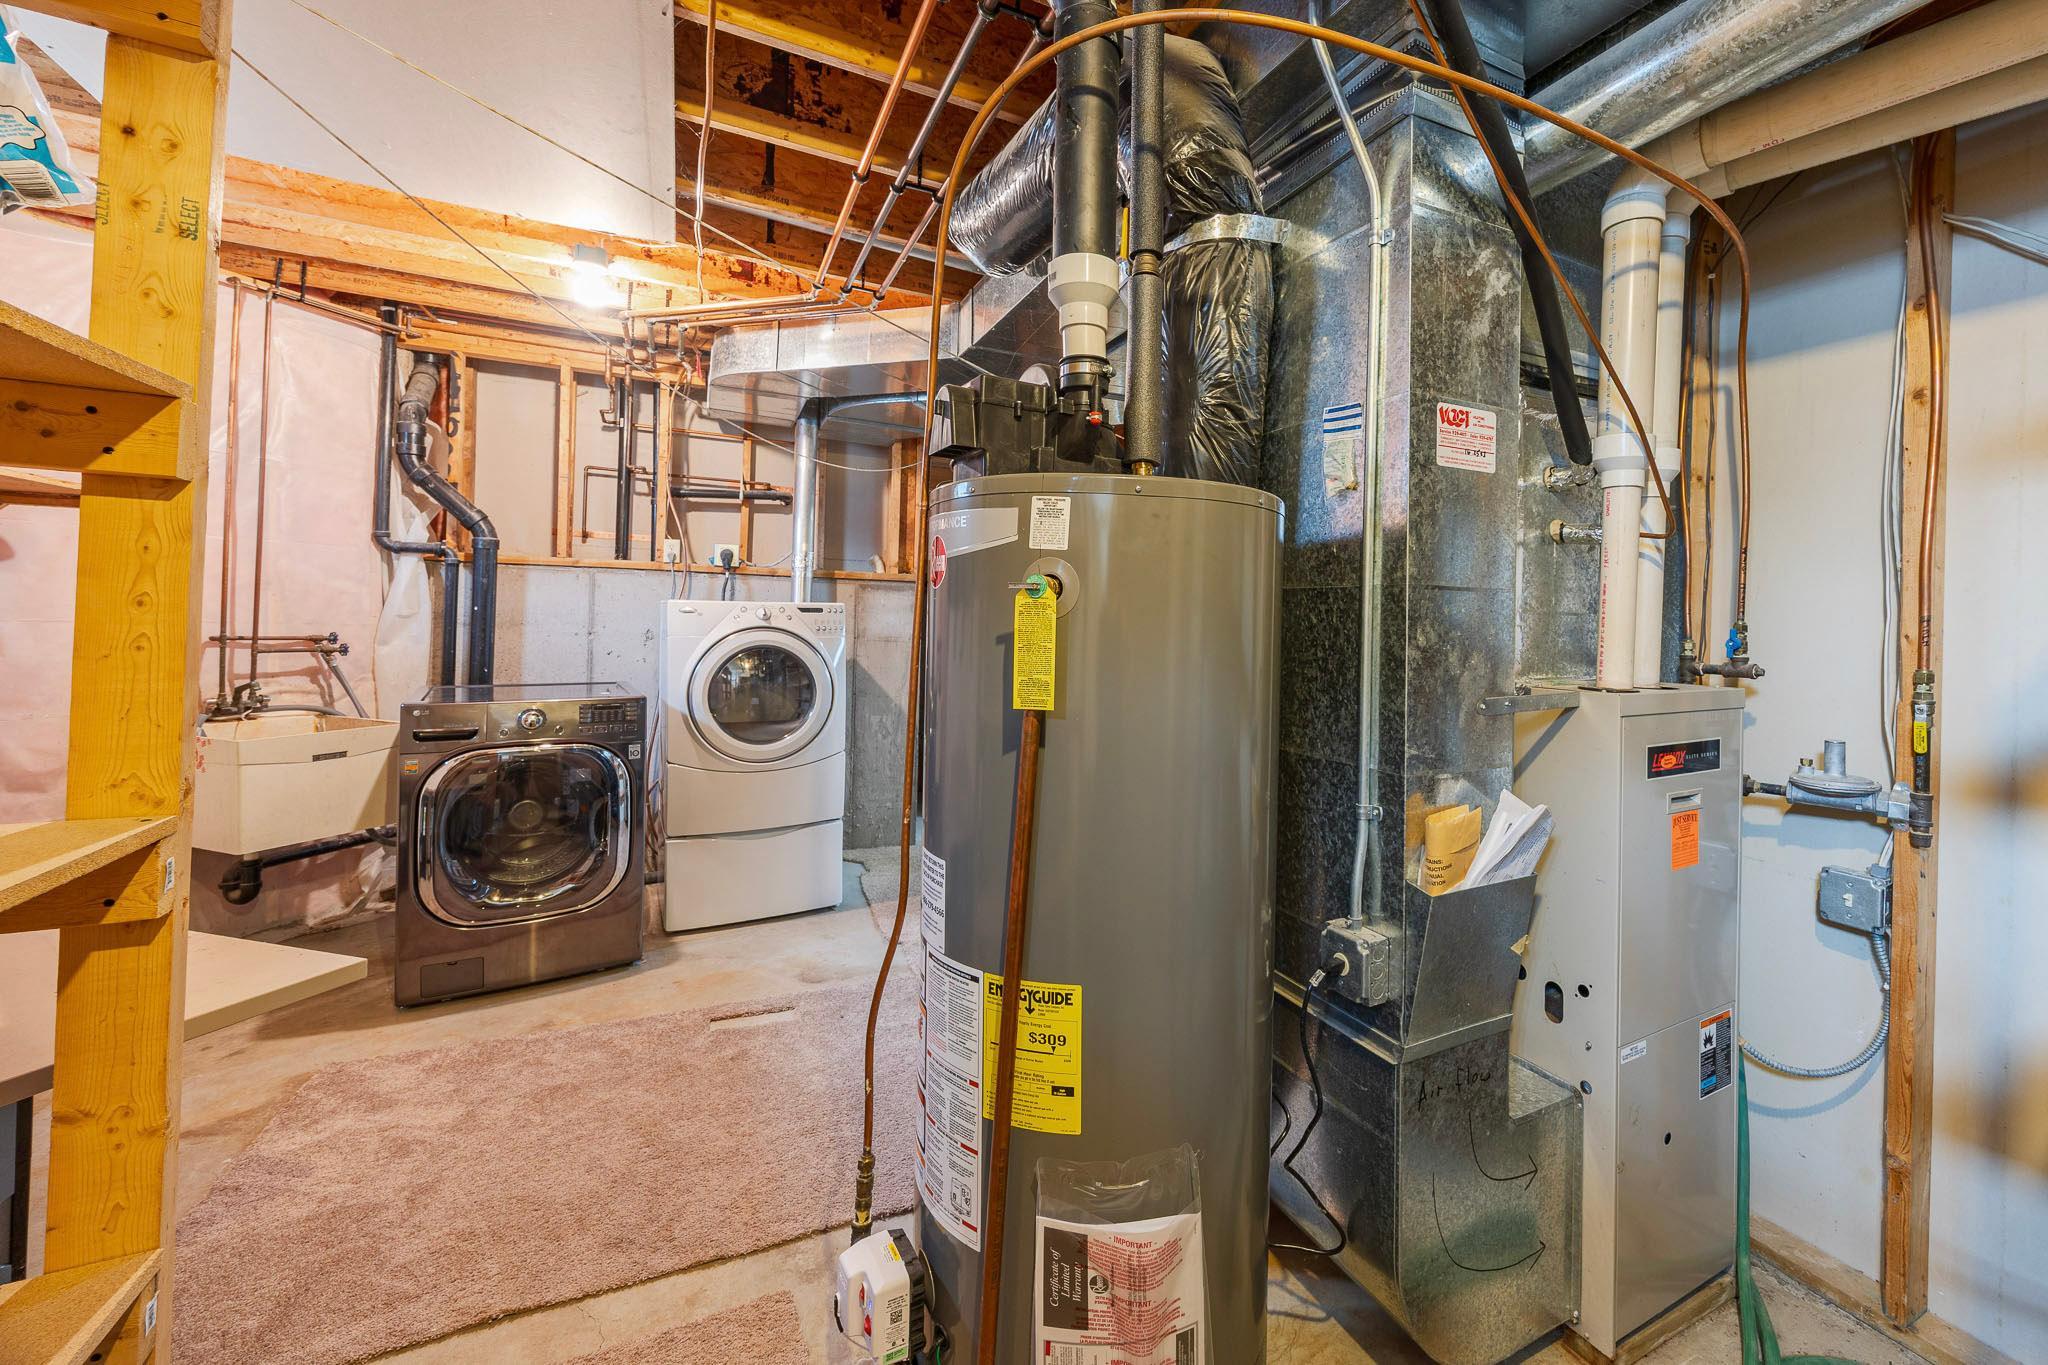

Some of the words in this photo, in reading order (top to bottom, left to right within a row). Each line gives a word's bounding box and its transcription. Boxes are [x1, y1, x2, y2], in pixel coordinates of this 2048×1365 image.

[178, 196, 200, 241] SELECT
[1652, 751, 1686, 768] LEOX
[989, 982, 1073, 1006] ENGYGUIDE
[1029, 1032, 1066, 1046] $309
[1417, 1080, 1443, 1112] Air
[1050, 1247, 1061, 1259] of
[1114, 1236, 1152, 1250] IMPORTANT
[1050, 1260, 1059, 1307] Certificate
[1062, 1263, 1070, 1298] Limited
[1072, 1262, 1083, 1302] Warranty
